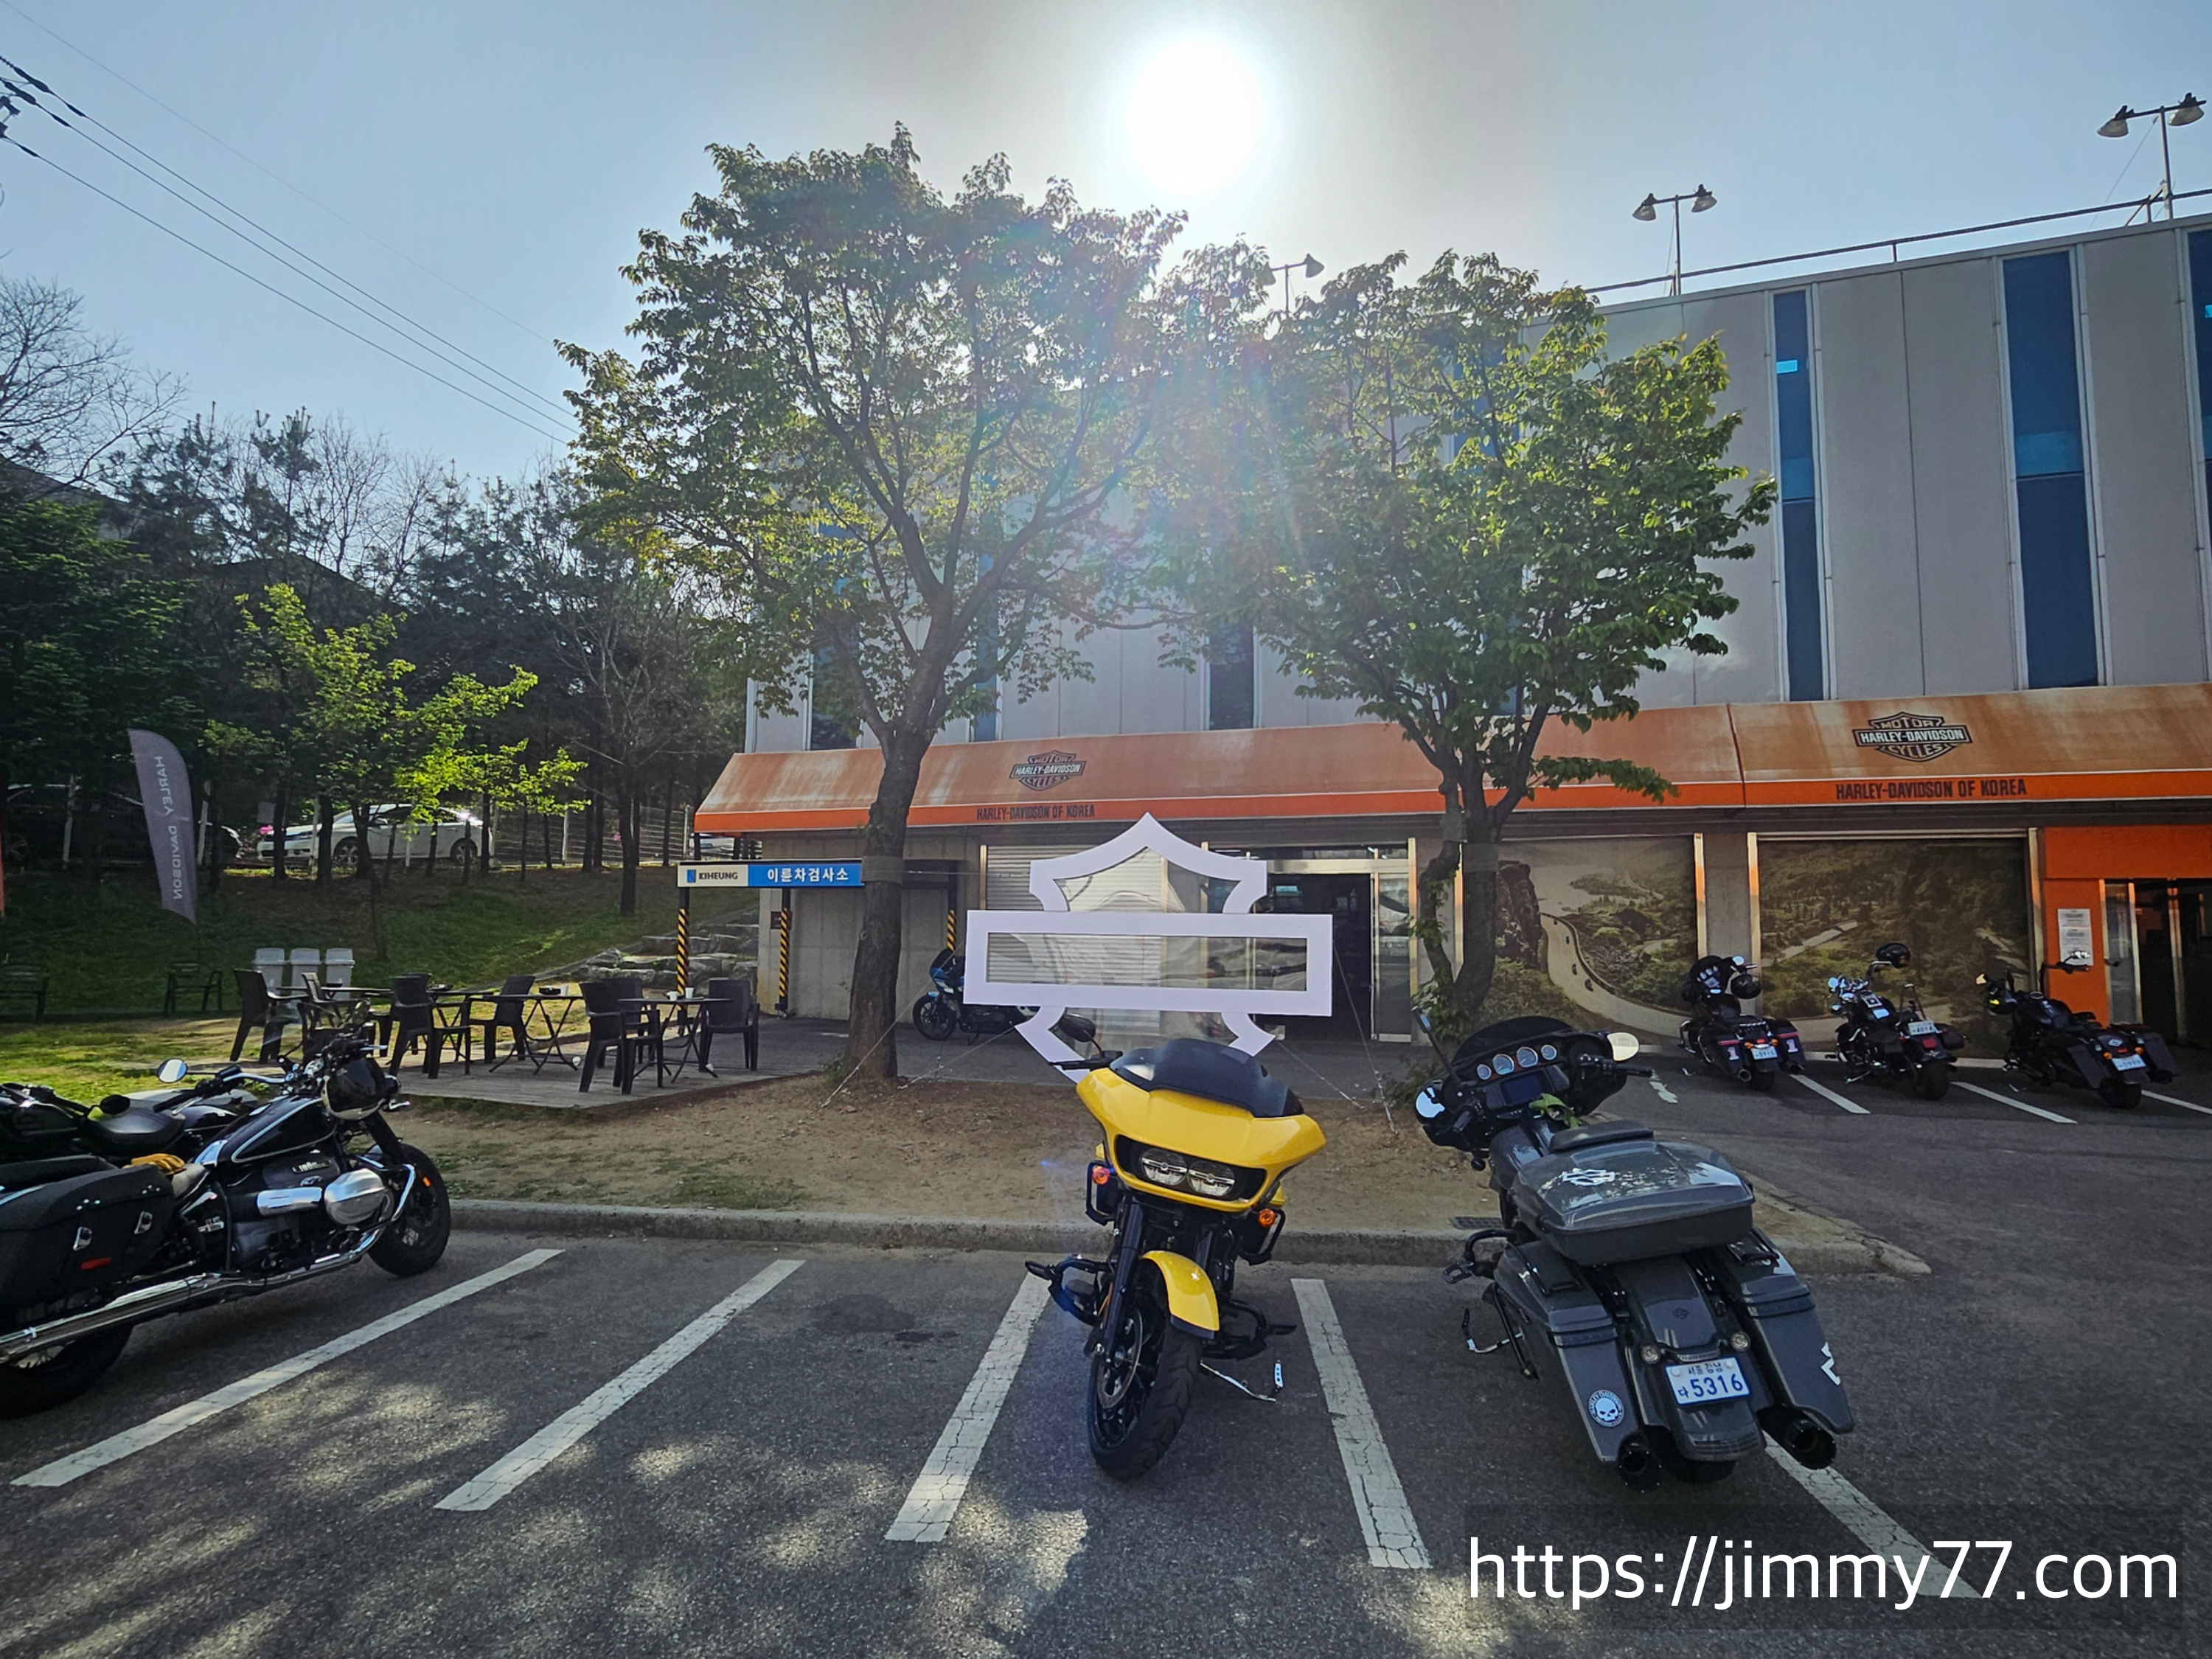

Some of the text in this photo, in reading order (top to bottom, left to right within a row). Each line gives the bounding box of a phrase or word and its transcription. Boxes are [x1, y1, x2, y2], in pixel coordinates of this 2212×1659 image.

[1880, 717, 1936, 728] MOTOR
[1860, 728, 1964, 743] HARLEY-DAVIDSON
[1888, 743, 1942, 758] CYCLES
[1034, 753, 1068, 764] MOTOR
[1015, 763, 1081, 776] HARLEY-DAVIDSON
[1024, 775, 1062, 788] CYCLES
[1835, 779, 2027, 800] HARLEY-DAVIDSON OF KOREA
[976, 804, 1095, 821] HARLEY-DAVIDSON OF KOREA
[698, 872, 738, 880] KIHEUNG
[767, 867, 849, 883] 이륜차검사소
[1727, 1047, 1739, 1060] 1
[1786, 1039, 1798, 1054] 1
[1690, 1374, 1744, 1397] 5316
